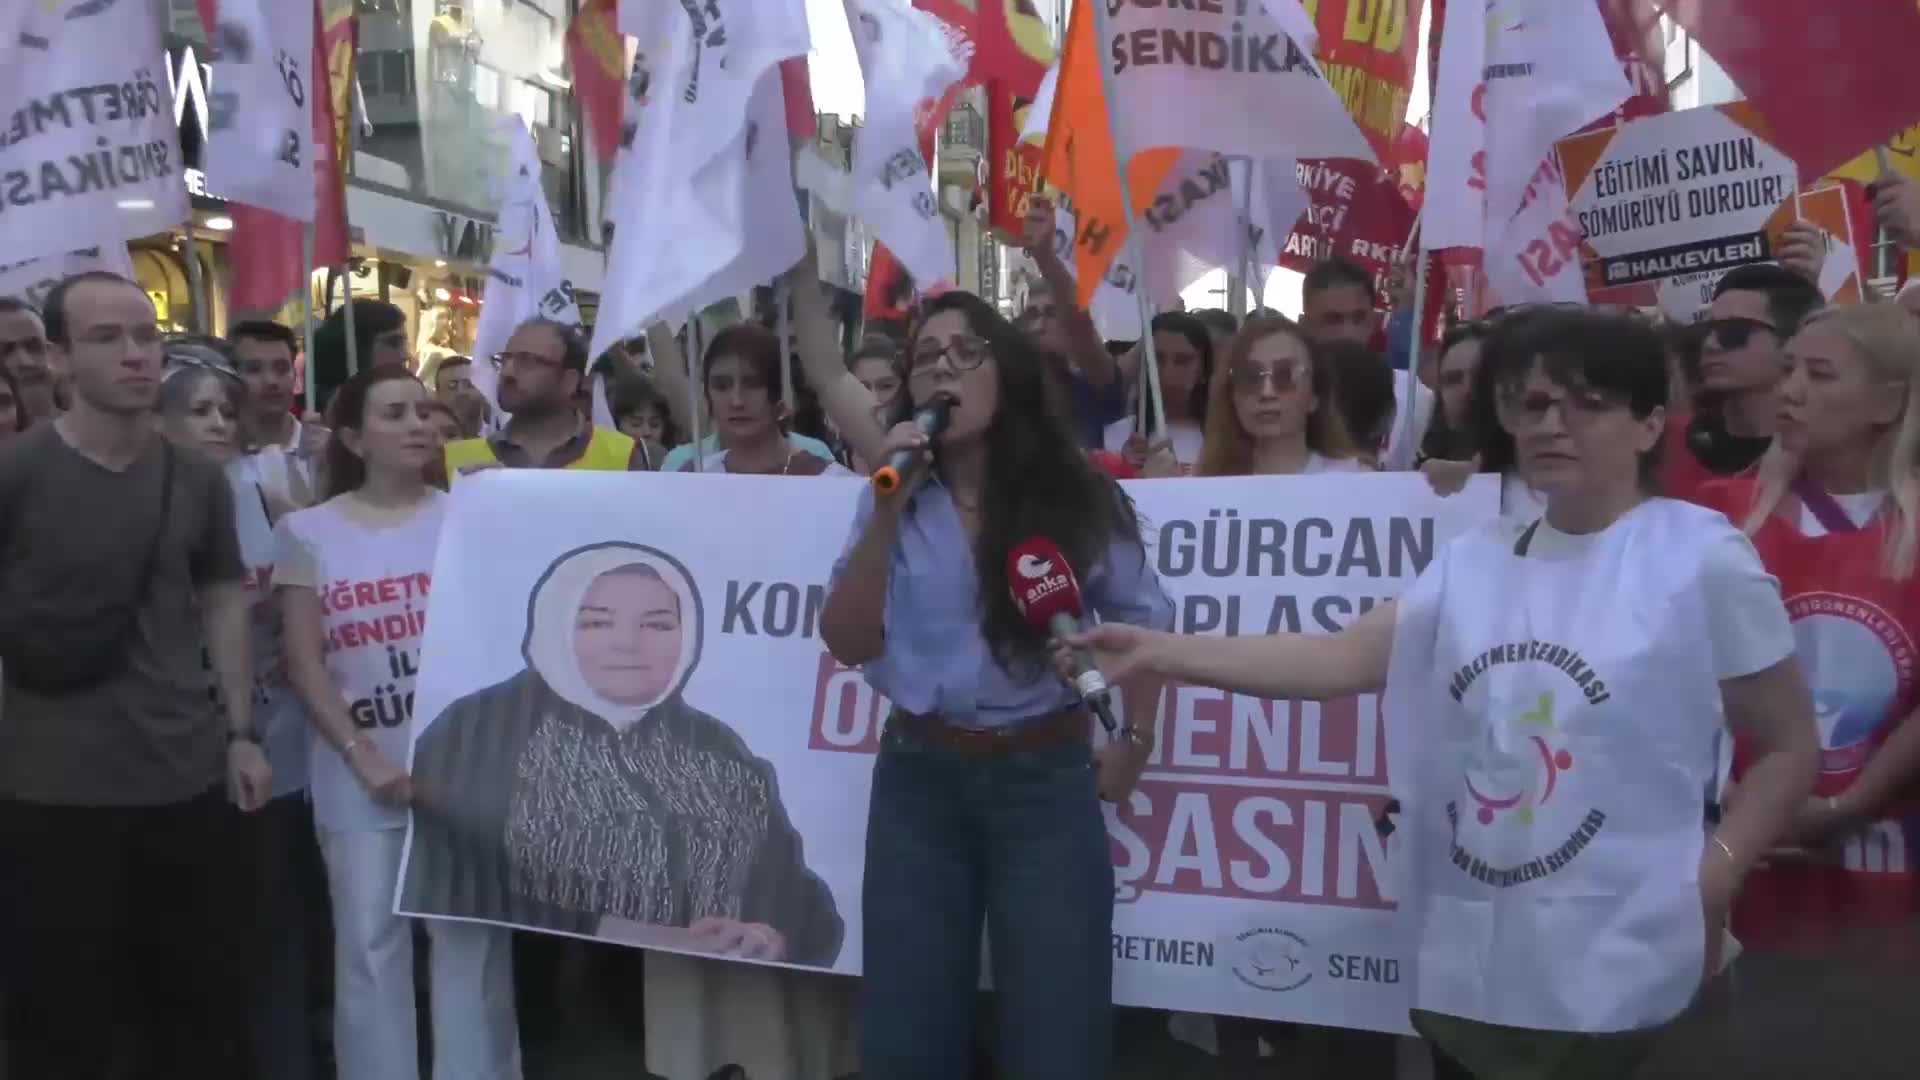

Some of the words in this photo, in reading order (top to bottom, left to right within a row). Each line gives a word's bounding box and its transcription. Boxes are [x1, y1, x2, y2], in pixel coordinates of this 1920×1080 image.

[1595, 149, 1669, 198] EĞİTİMİ
[1676, 136, 1763, 181] SAVUN,
[1578, 189, 1680, 240] SÖMÜRÜYÜ
[1688, 174, 1783, 220] DURDUR!
[1631, 236, 1763, 277] HALKEVLERİ
[1157, 508, 1434, 578] GÜRCAN
[1027, 575, 1067, 600] anka
[1099, 789, 1397, 902] ŞASIN
[1112, 934, 1214, 967] RETMEN
[1327, 953, 1400, 984] SEND
